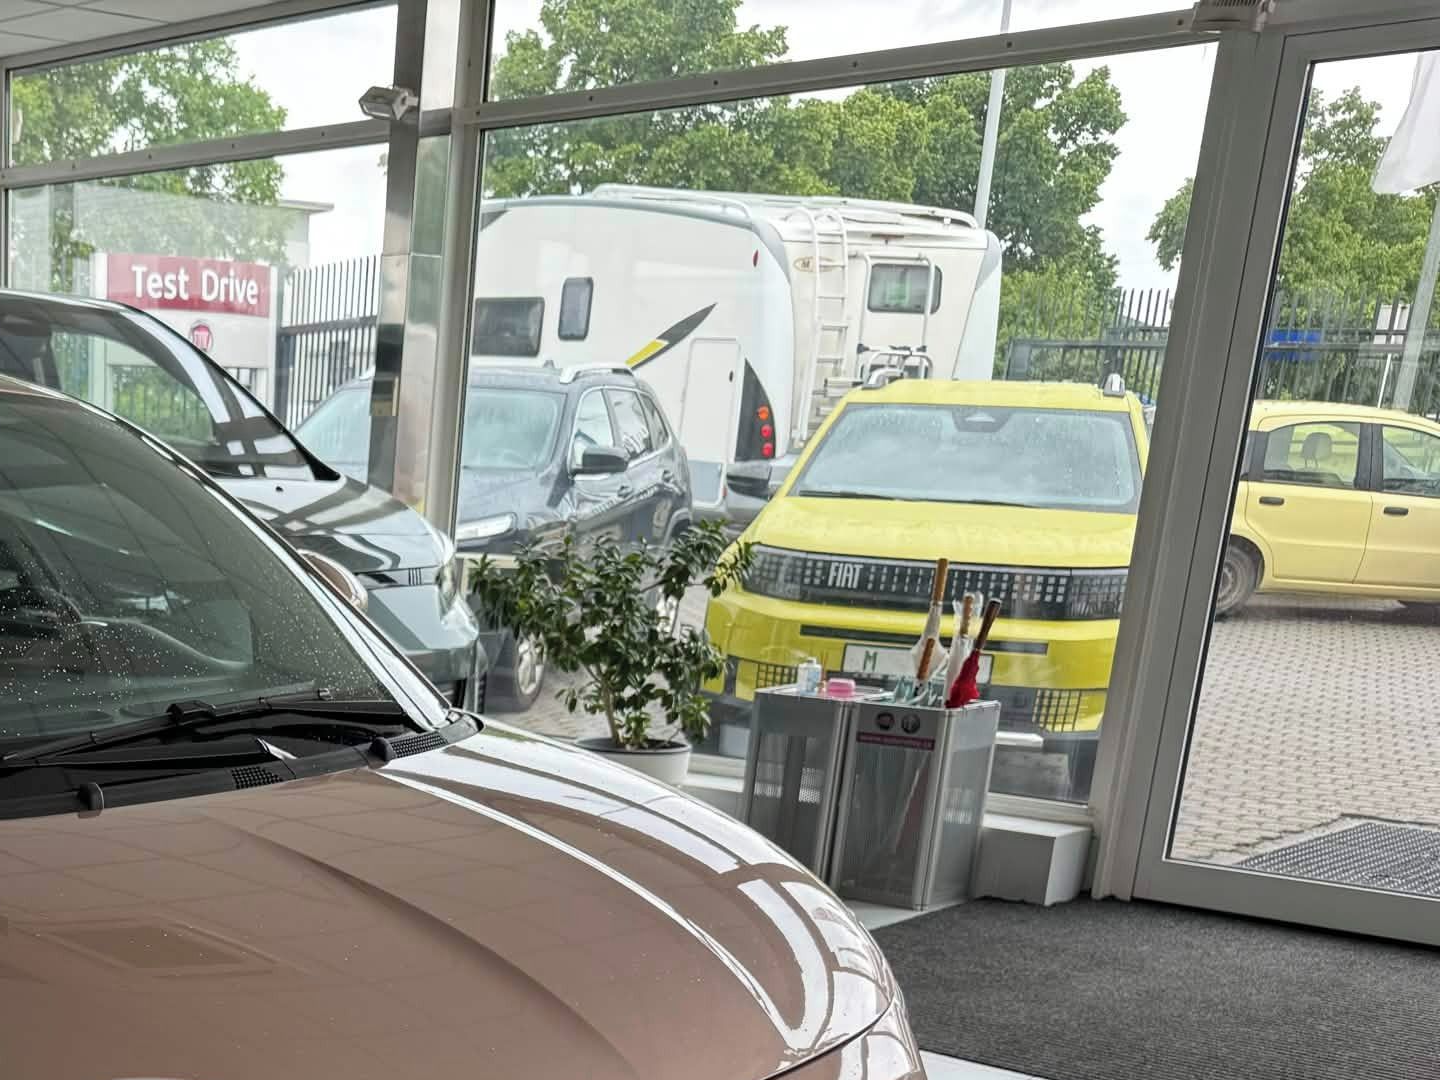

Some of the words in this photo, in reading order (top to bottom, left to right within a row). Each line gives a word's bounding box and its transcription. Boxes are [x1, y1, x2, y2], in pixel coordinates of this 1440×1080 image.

[131, 264, 189, 300] Test
[201, 268, 259, 305] Drive
[827, 562, 864, 589] FIAT
